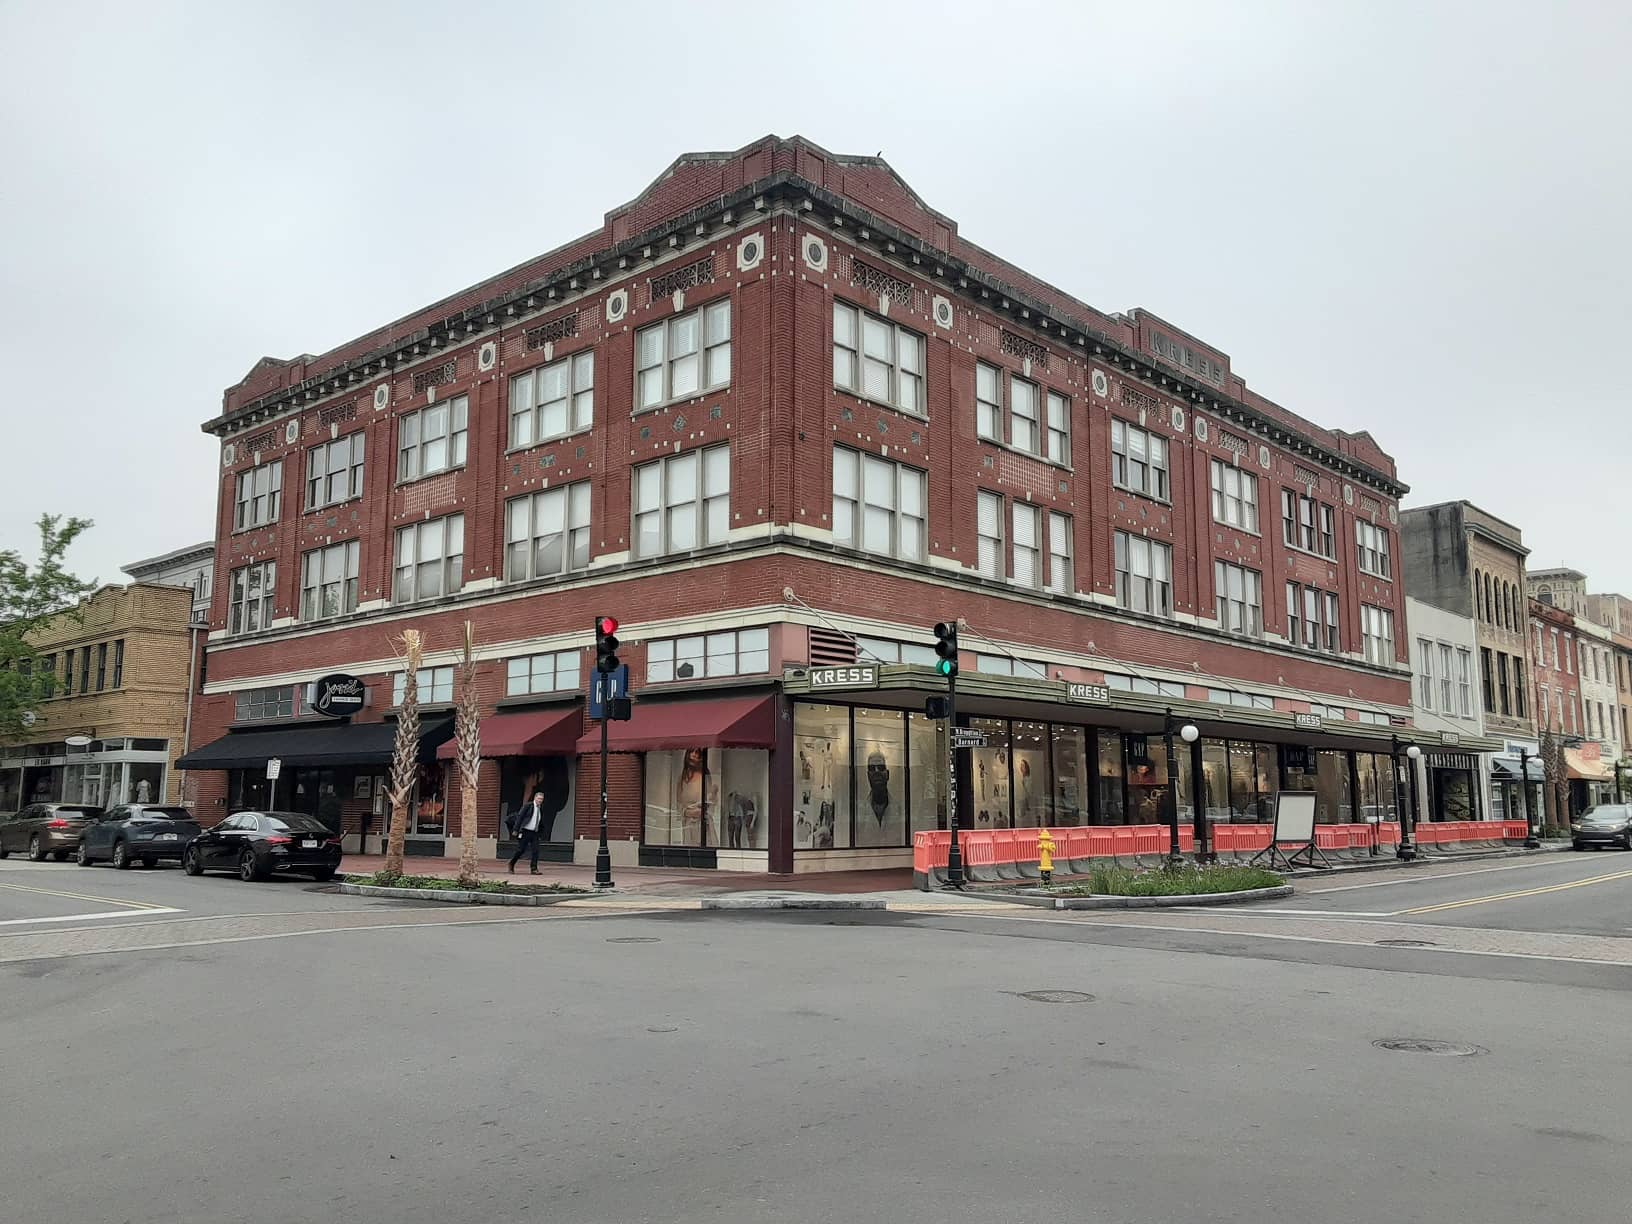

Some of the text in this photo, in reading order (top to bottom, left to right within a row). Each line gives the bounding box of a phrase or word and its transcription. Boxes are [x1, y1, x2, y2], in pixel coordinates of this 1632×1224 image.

[812, 668, 873, 684] KRESS
[595, 679, 617, 704] GP
[1070, 684, 1108, 699] KRESS
[1296, 714, 1320, 726] KRESS
